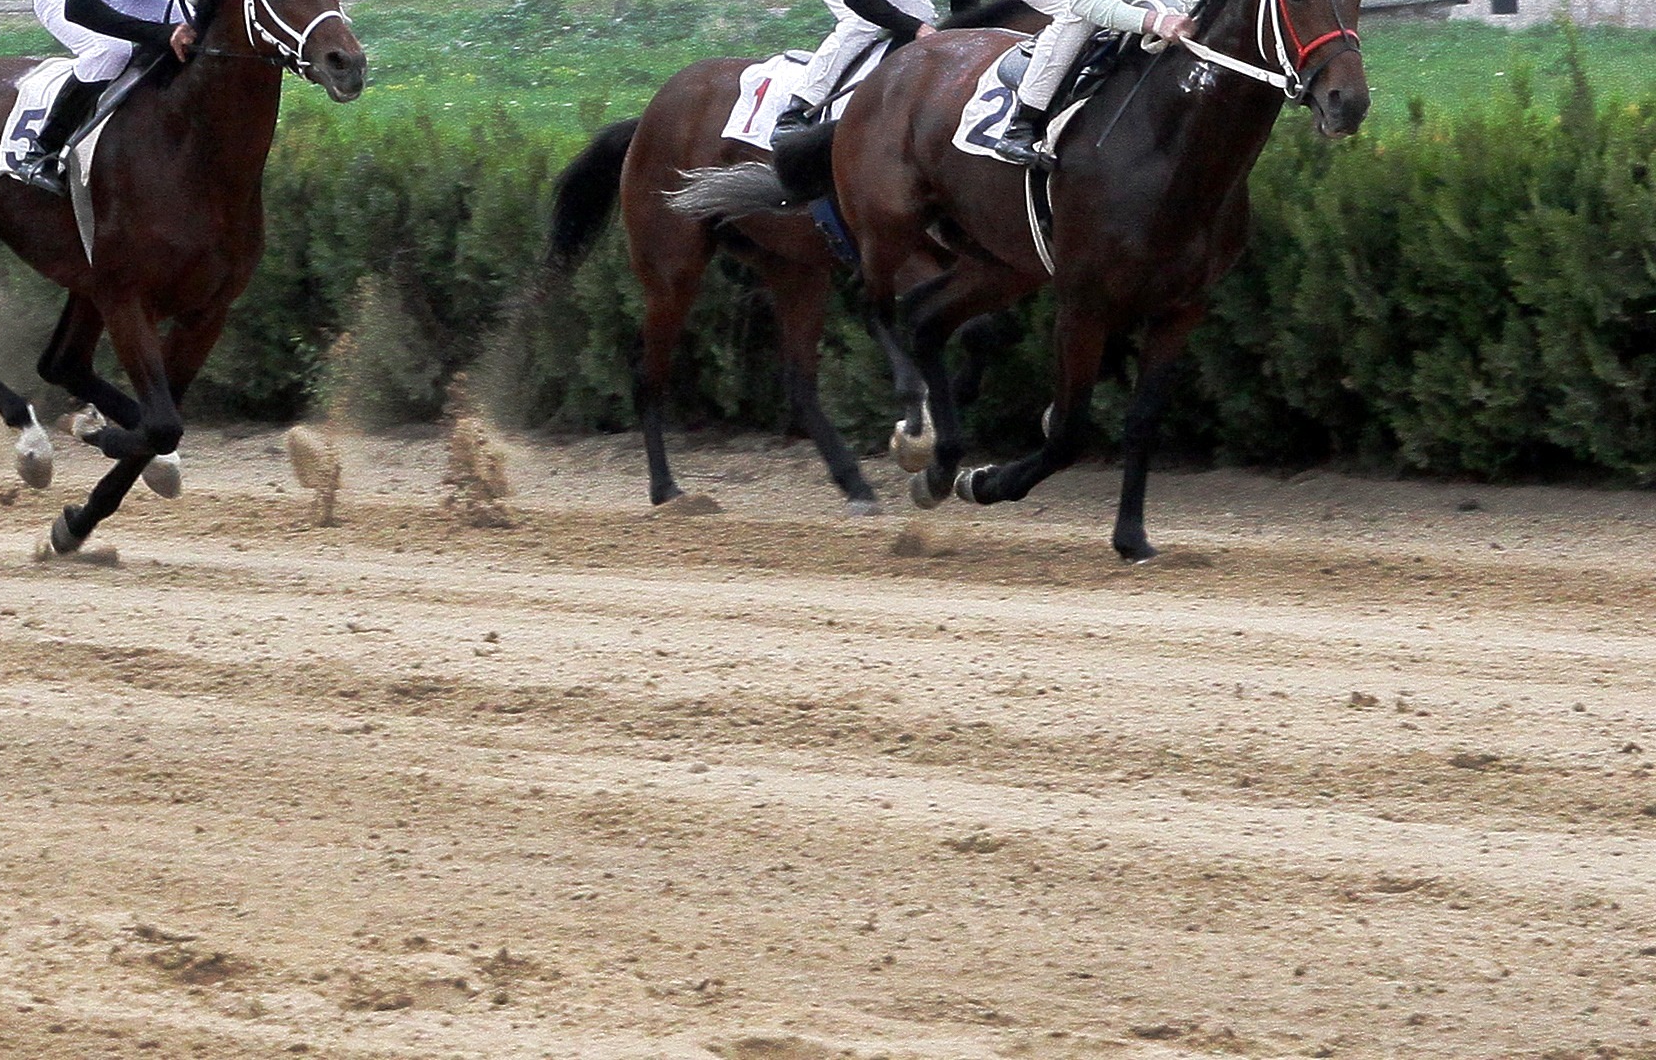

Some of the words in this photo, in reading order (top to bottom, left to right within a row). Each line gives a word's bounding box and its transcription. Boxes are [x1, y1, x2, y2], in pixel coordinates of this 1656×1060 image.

[742, 78, 772, 134] 1
[965, 86, 1013, 150] 2
[5, 107, 47, 171] 5
